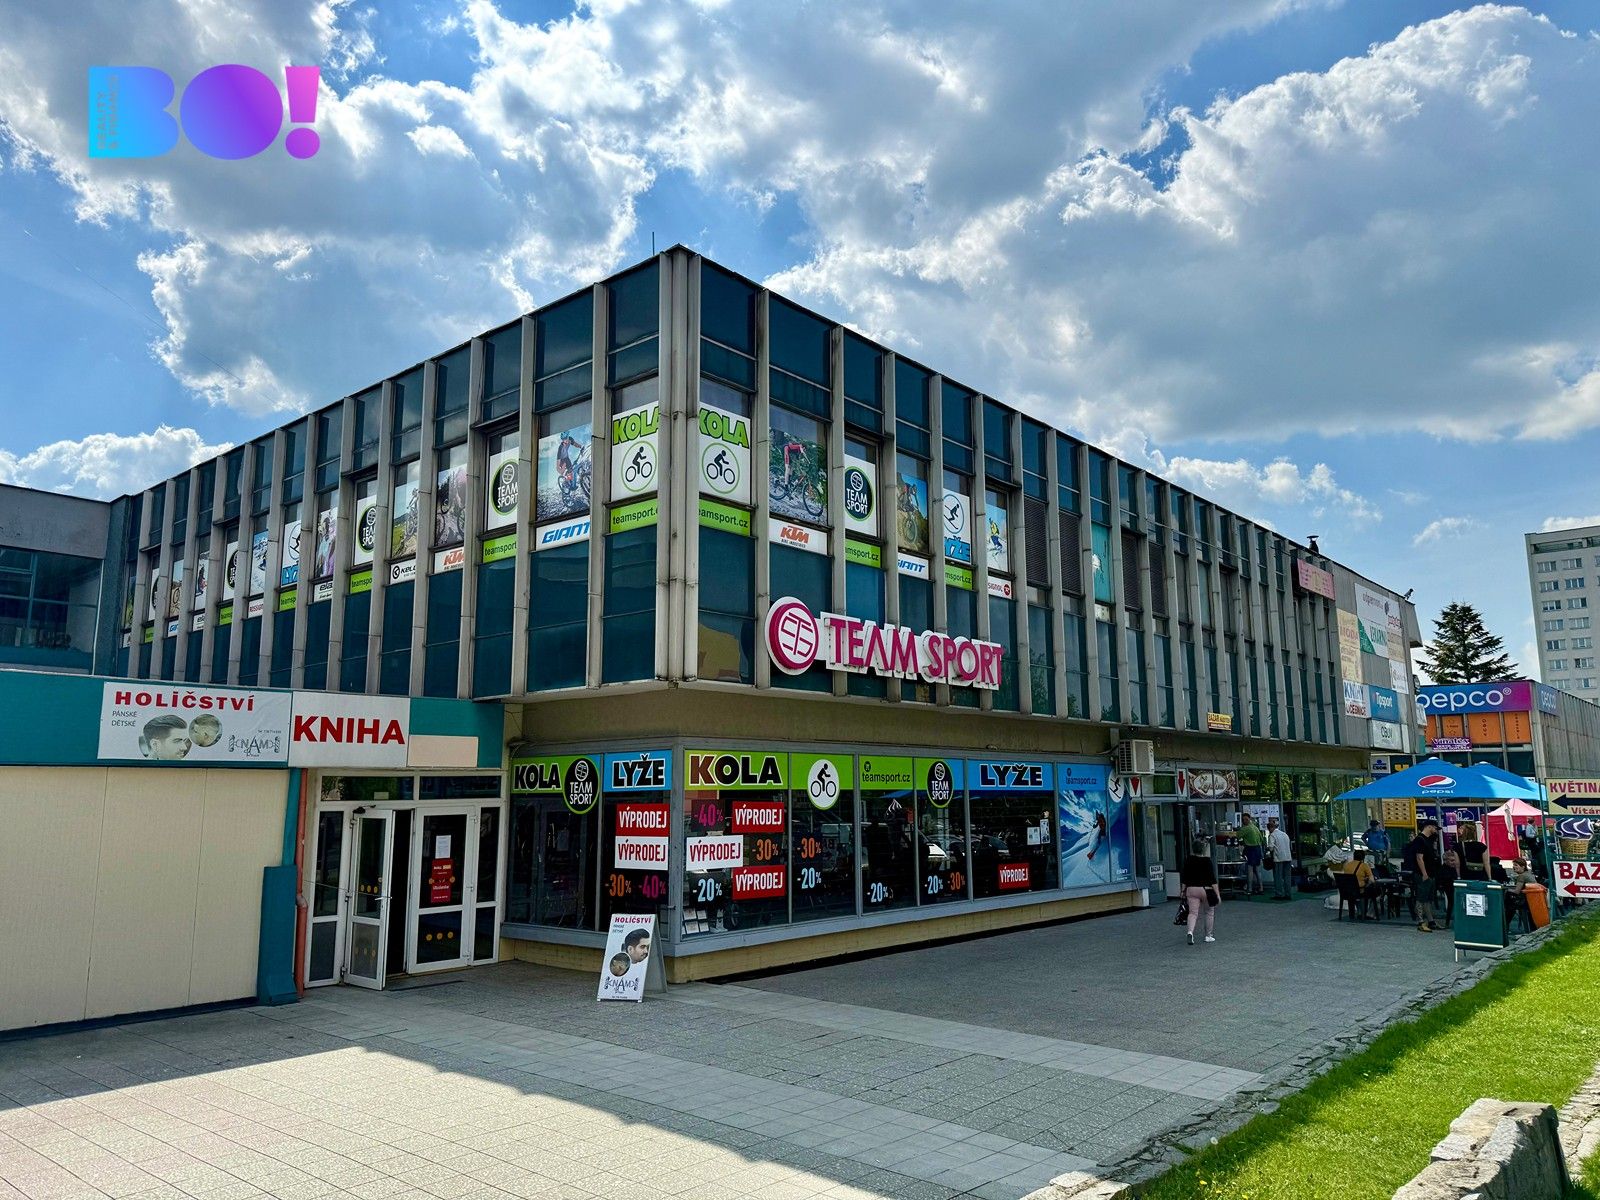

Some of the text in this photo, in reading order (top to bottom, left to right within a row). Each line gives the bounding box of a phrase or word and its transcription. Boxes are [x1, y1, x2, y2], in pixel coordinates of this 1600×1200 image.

[846, 488, 868, 504] TEAM
[846, 500, 868, 515] SPORT
[780, 525, 810, 544] KTM
[945, 571, 972, 585] msport.cz
[829, 617, 1005, 685] TEAM SPORT
[293, 715, 406, 745] KNIHA
[513, 763, 562, 791] KOLA
[612, 753, 665, 788] LYŽE
[689, 754, 783, 787] KOLA
[862, 773, 911, 785] teamsport.cz
[980, 762, 1043, 787] LYŽE
[570, 781, 593, 794] TEAM
[931, 780, 949, 791] TEAM
[931, 790, 949, 800] SPORT
[569, 793, 593, 805] SPORT
[619, 806, 667, 828] VÝPRODEJ
[694, 804, 724, 828] -40%
[735, 803, 782, 826] VÝPRODEJ
[618, 839, 666, 862] VÝPRODEJ
[689, 840, 741, 862] VÝPRODEJ
[752, 838, 779, 861] -30%
[797, 837, 822, 859] -30%
[605, 874, 632, 897] -30%
[735, 869, 783, 892] VÝPRODEJ
[797, 867, 822, 889] -20%
[924, 875, 944, 894] -20%
[1000, 866, 1029, 883] VÝPRODEJ
[638, 875, 667, 898] -40%
[692, 878, 723, 902] -20%
[867, 882, 889, 903] -20%
